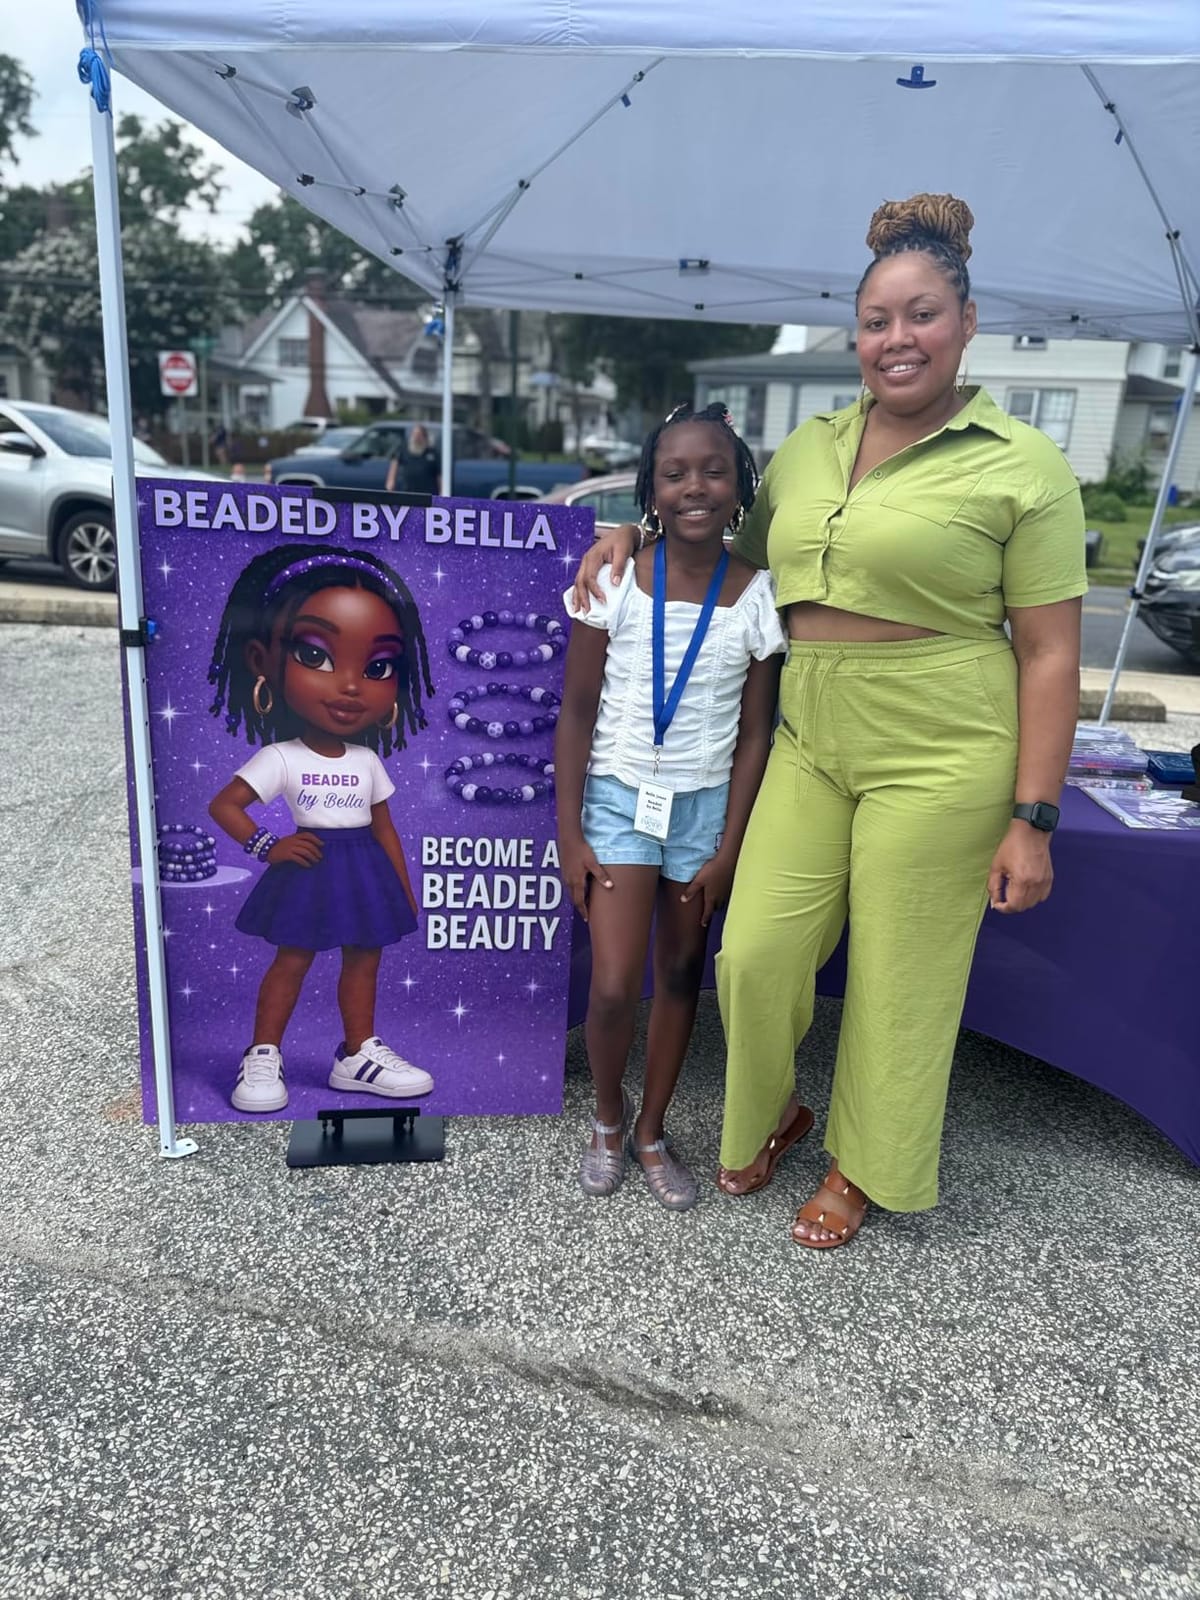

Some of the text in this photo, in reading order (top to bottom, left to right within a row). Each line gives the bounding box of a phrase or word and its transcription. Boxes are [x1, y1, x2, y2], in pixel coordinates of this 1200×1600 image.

[154, 489, 558, 551] BEADED BY BELLA
[301, 773, 359, 787] BEADED
[297, 788, 365, 811] by Bella
[422, 836, 560, 868] BECOME A
[422, 873, 562, 910] BEADED
[427, 914, 560, 950] BEAUTY
